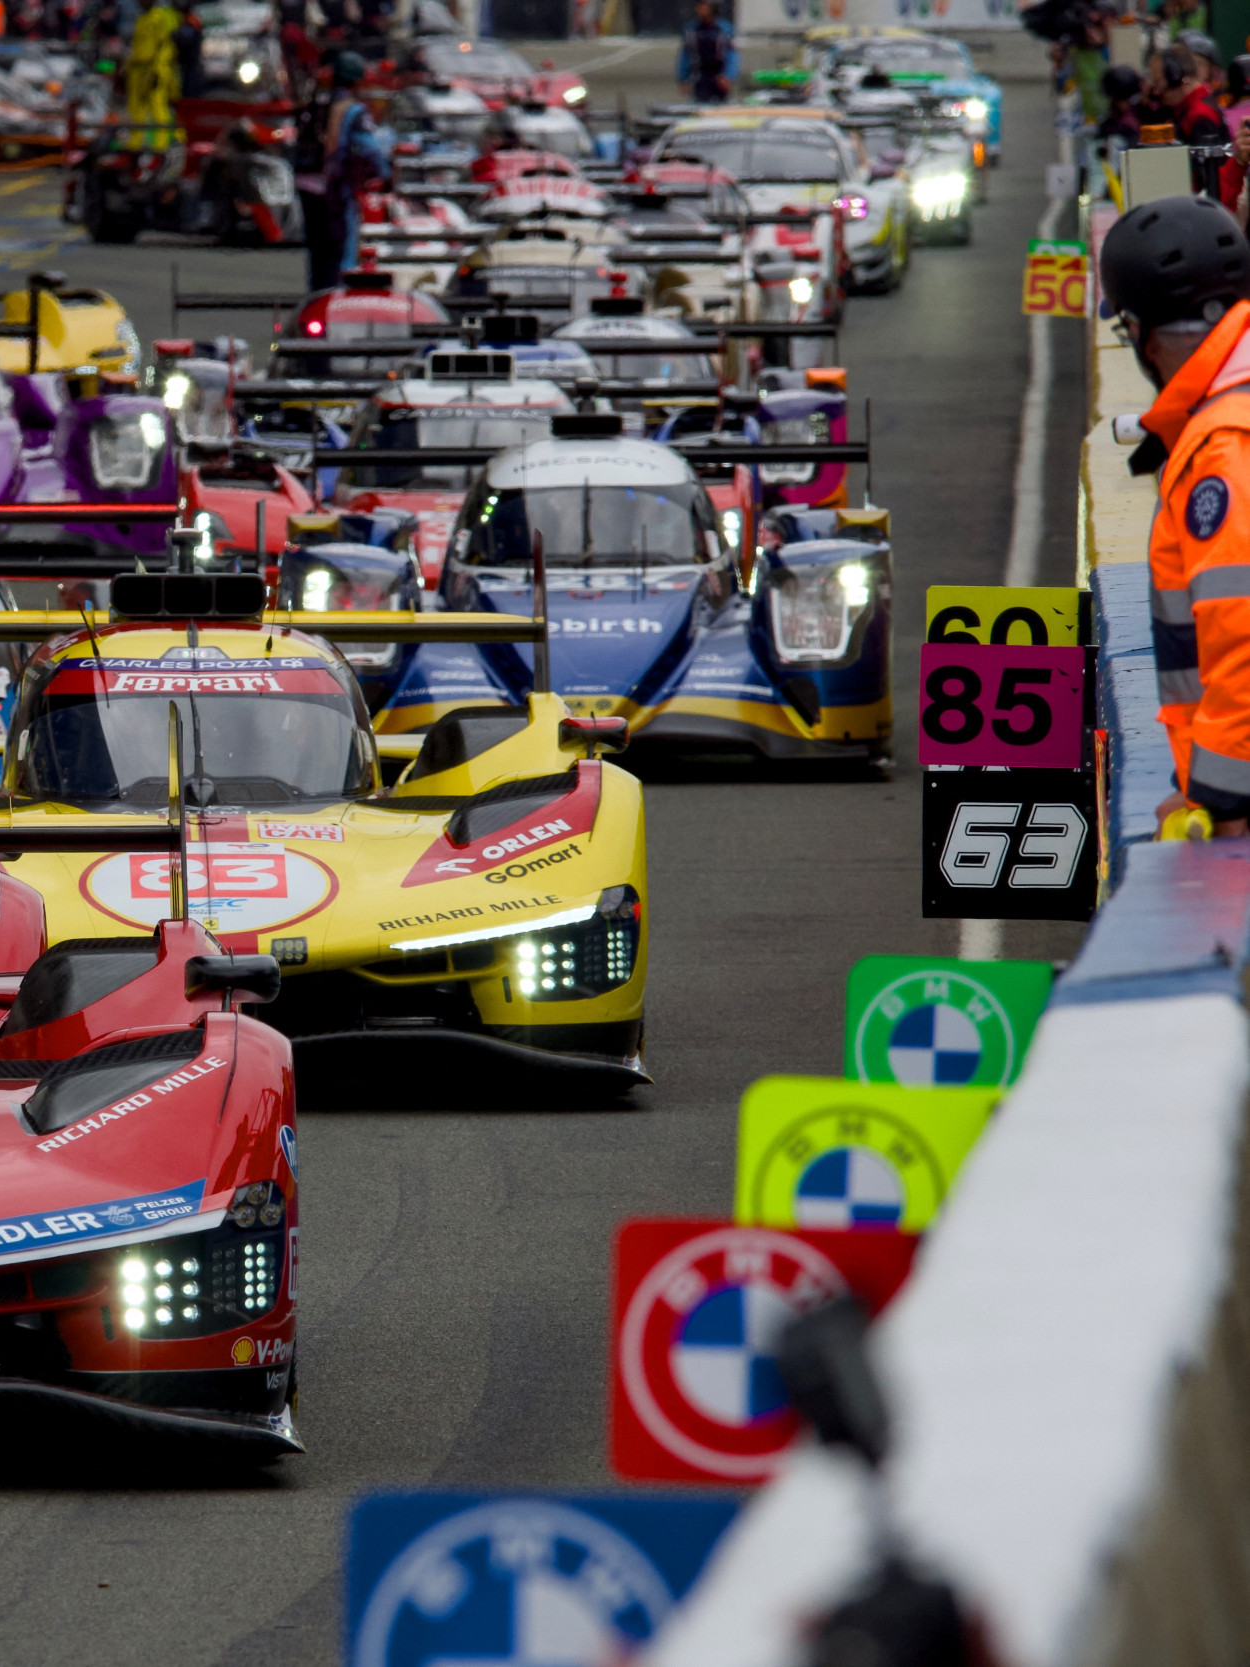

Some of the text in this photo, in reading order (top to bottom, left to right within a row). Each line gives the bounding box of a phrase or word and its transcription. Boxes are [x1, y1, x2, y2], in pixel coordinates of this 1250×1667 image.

[1028, 273, 1086, 312] 50
[546, 617, 663, 634] ebirth
[78, 658, 273, 670] CHARLES POZZI
[107, 671, 284, 692] Ferrari
[921, 664, 1054, 747] 85
[263, 823, 337, 833] HYPER
[265, 829, 338, 841] CAR
[481, 818, 573, 860] ORLEN
[939, 801, 1089, 889] 63
[138, 858, 279, 891] 83
[484, 843, 583, 885] GOmart
[378, 894, 563, 931] RICHARD MILLE
[877, 977, 993, 1022] BMW
[36, 1055, 228, 1153] RICHARD MILLE
[134, 1196, 187, 1211] PELZER
[143, 1204, 194, 1221] GROUP
